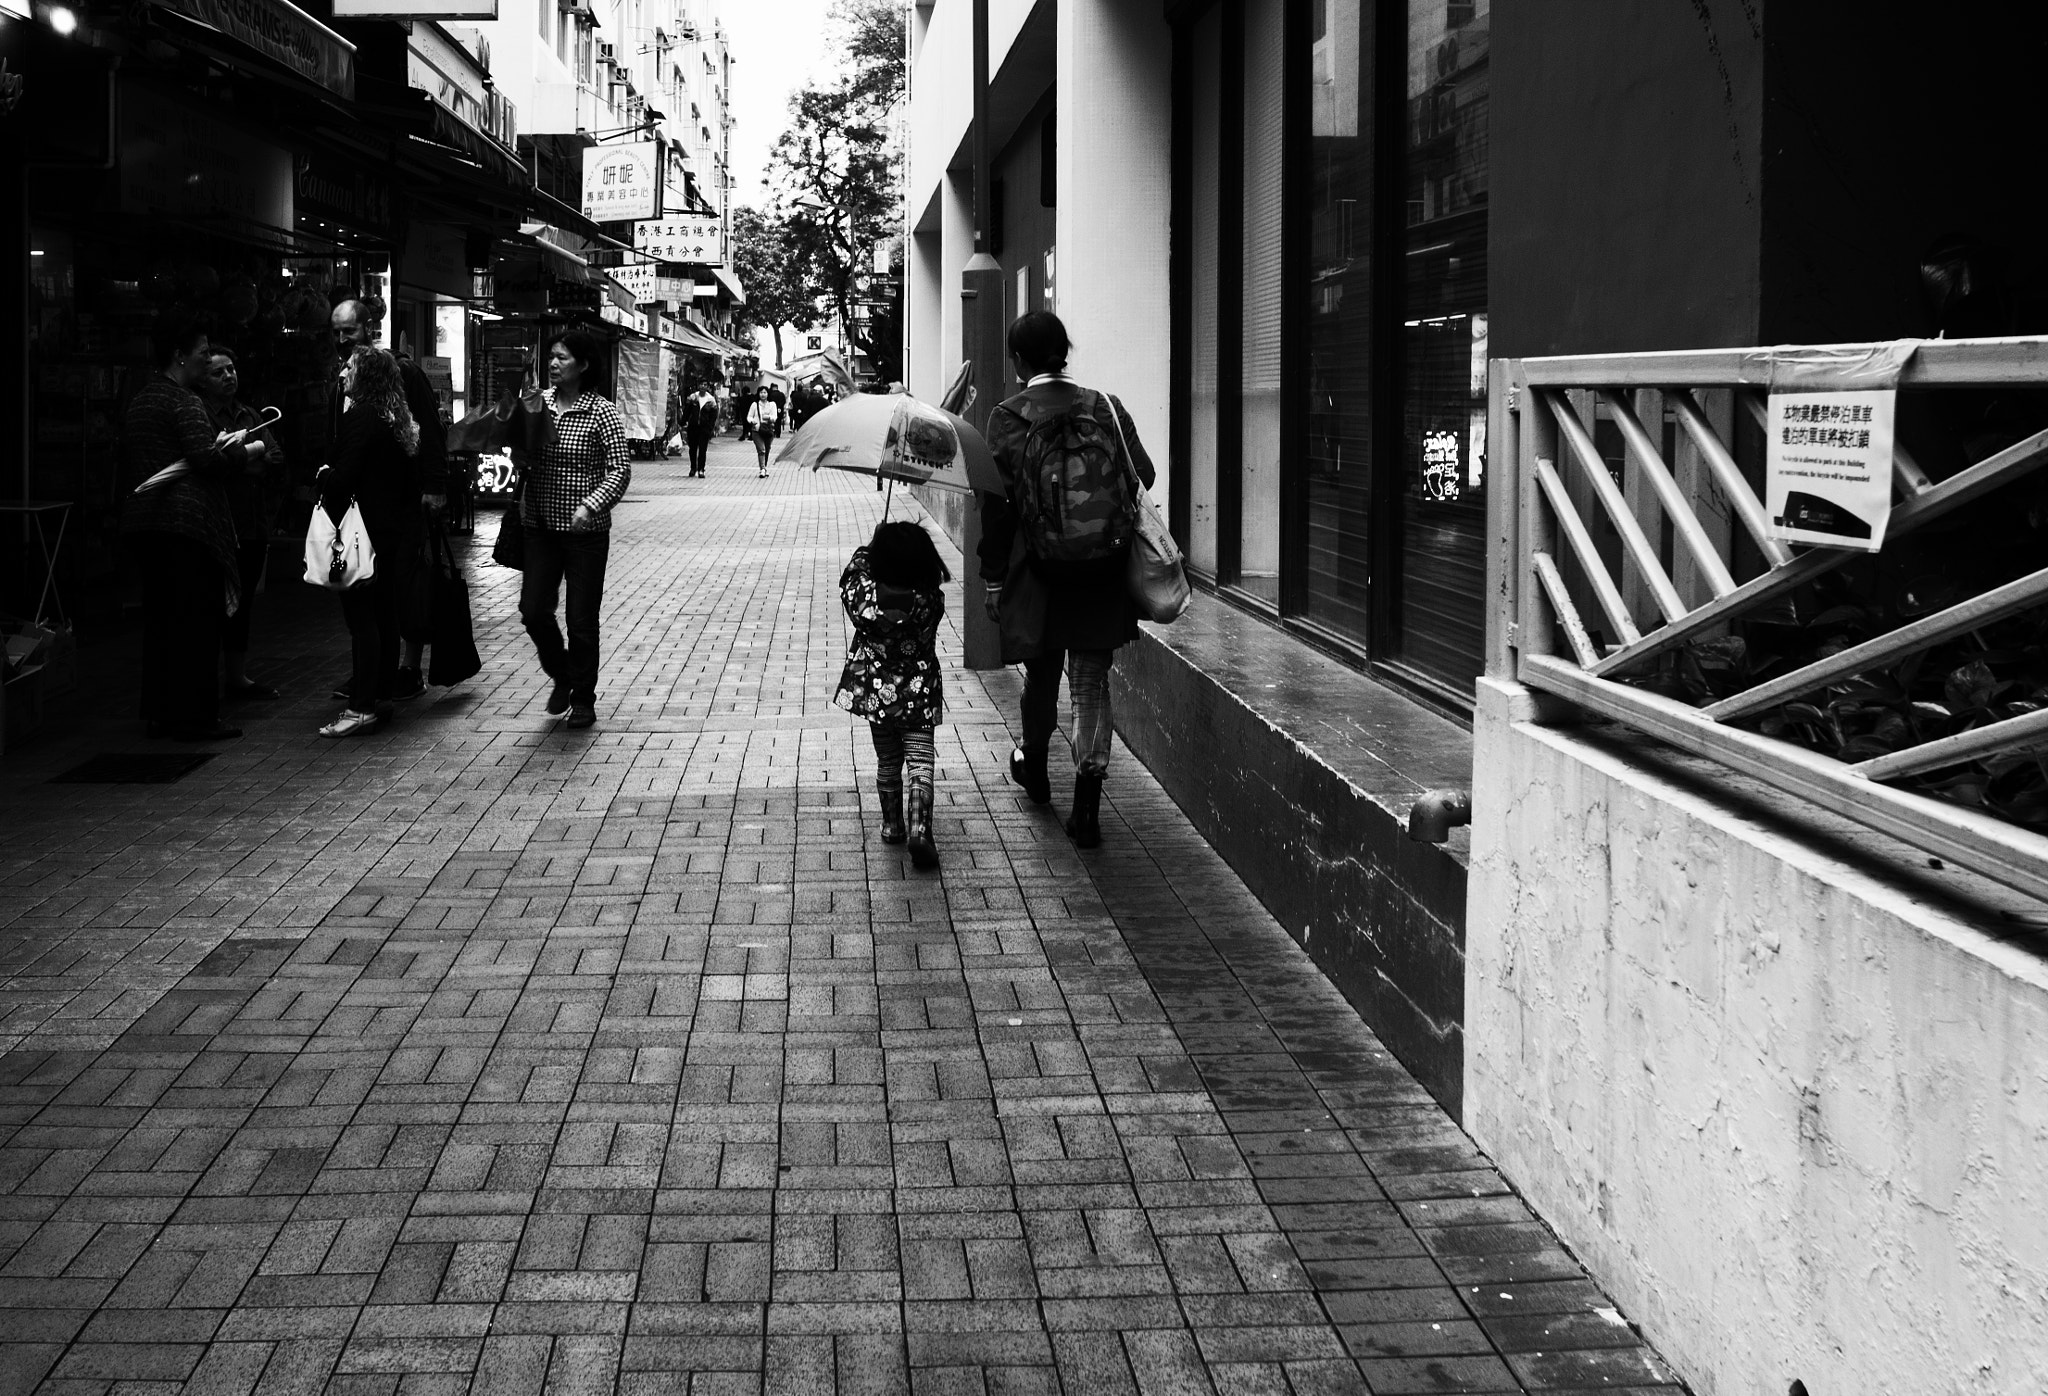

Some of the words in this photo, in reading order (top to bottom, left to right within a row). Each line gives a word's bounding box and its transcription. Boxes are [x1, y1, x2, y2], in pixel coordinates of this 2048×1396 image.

[586, 186, 649, 203] 專業美容中心
[651, 245, 704, 258] 西貢分會
[903, 454, 943, 469] STITCH
[1803, 456, 1818, 464] allowed
[1847, 459, 1866, 469] Building
[1845, 475, 1871, 483] impounded
